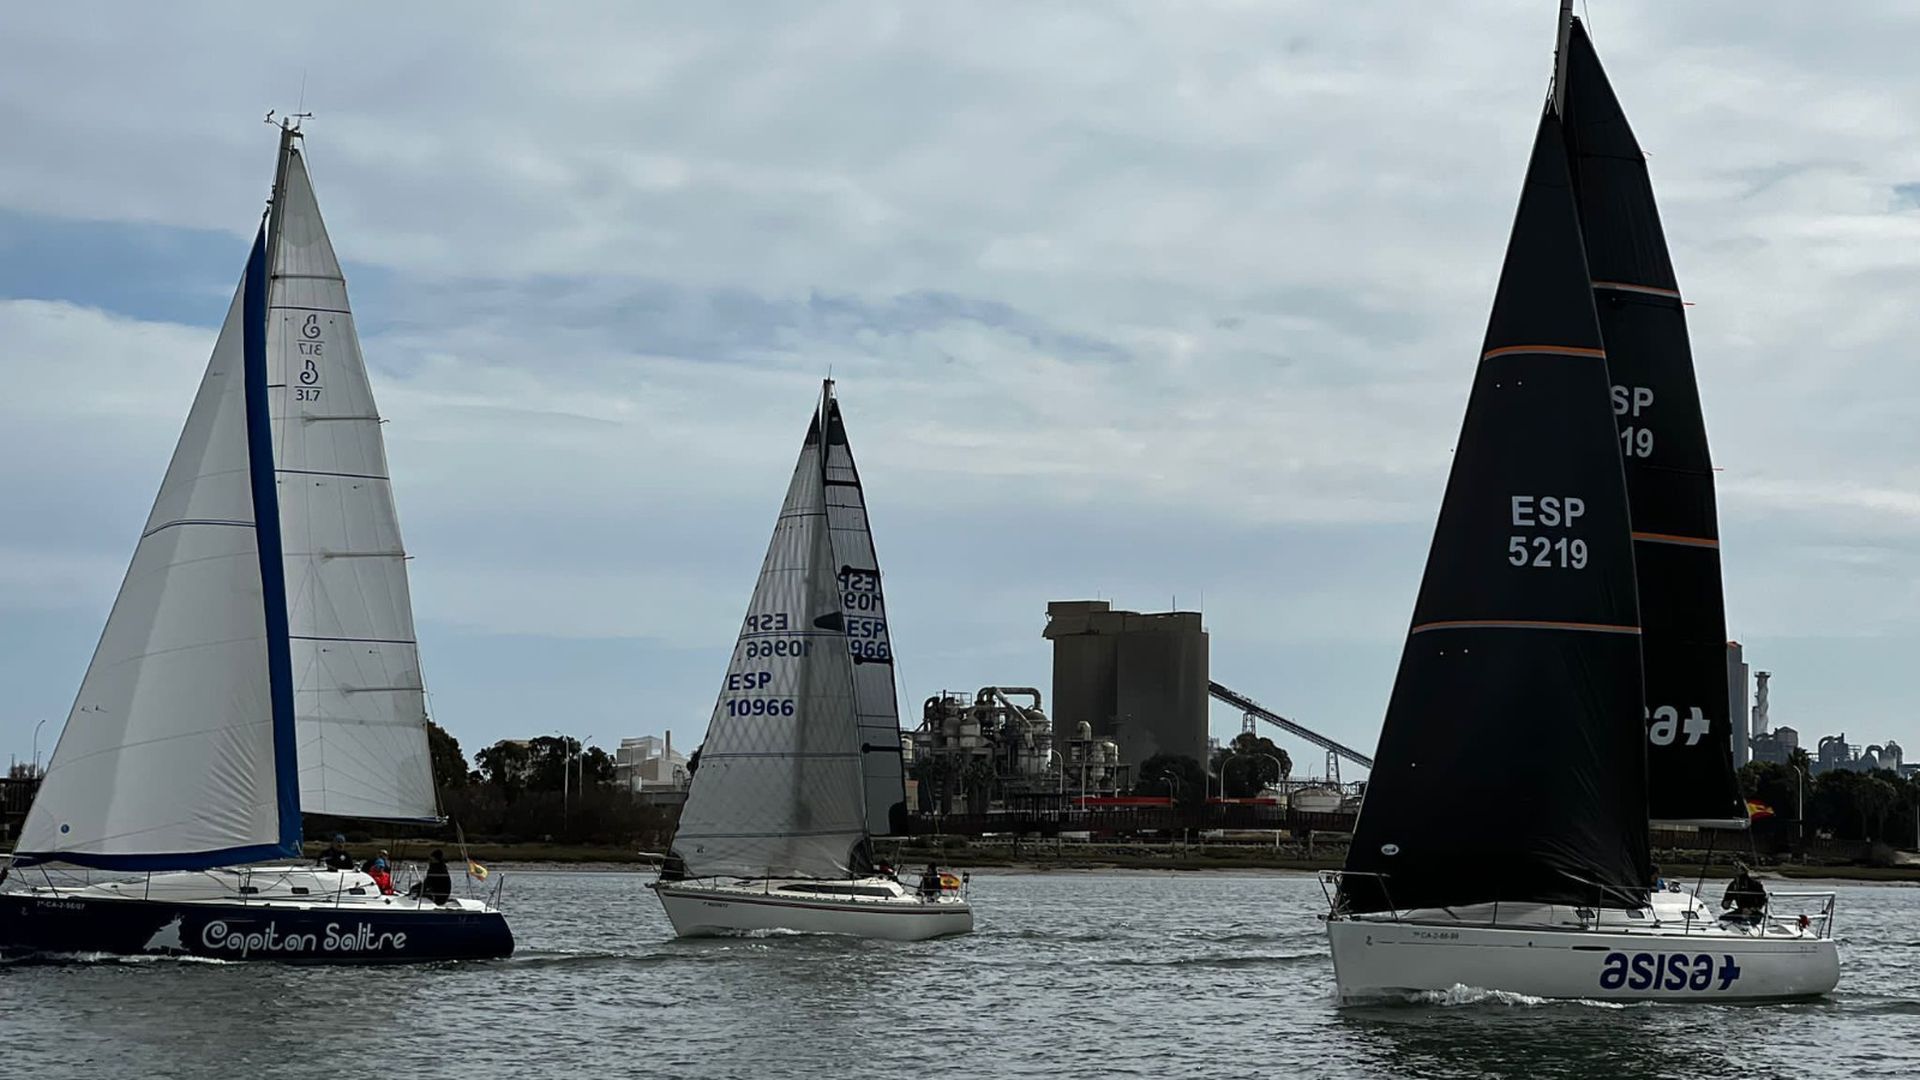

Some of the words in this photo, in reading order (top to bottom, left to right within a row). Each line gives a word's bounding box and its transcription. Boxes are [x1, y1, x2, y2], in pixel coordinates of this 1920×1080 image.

[296, 389, 320, 401] 31.7
[1611, 385, 1654, 417] SP
[1620, 426, 1654, 458] 19
[1511, 496, 1585, 527] ESP
[1508, 536, 1588, 569] 5219
[847, 620, 885, 639] ESP
[851, 641, 888, 657] 966
[728, 672, 772, 690] ESP
[726, 699, 794, 717] 10966
[202, 920, 317, 958] Capitan
[323, 922, 407, 951] Salitre
